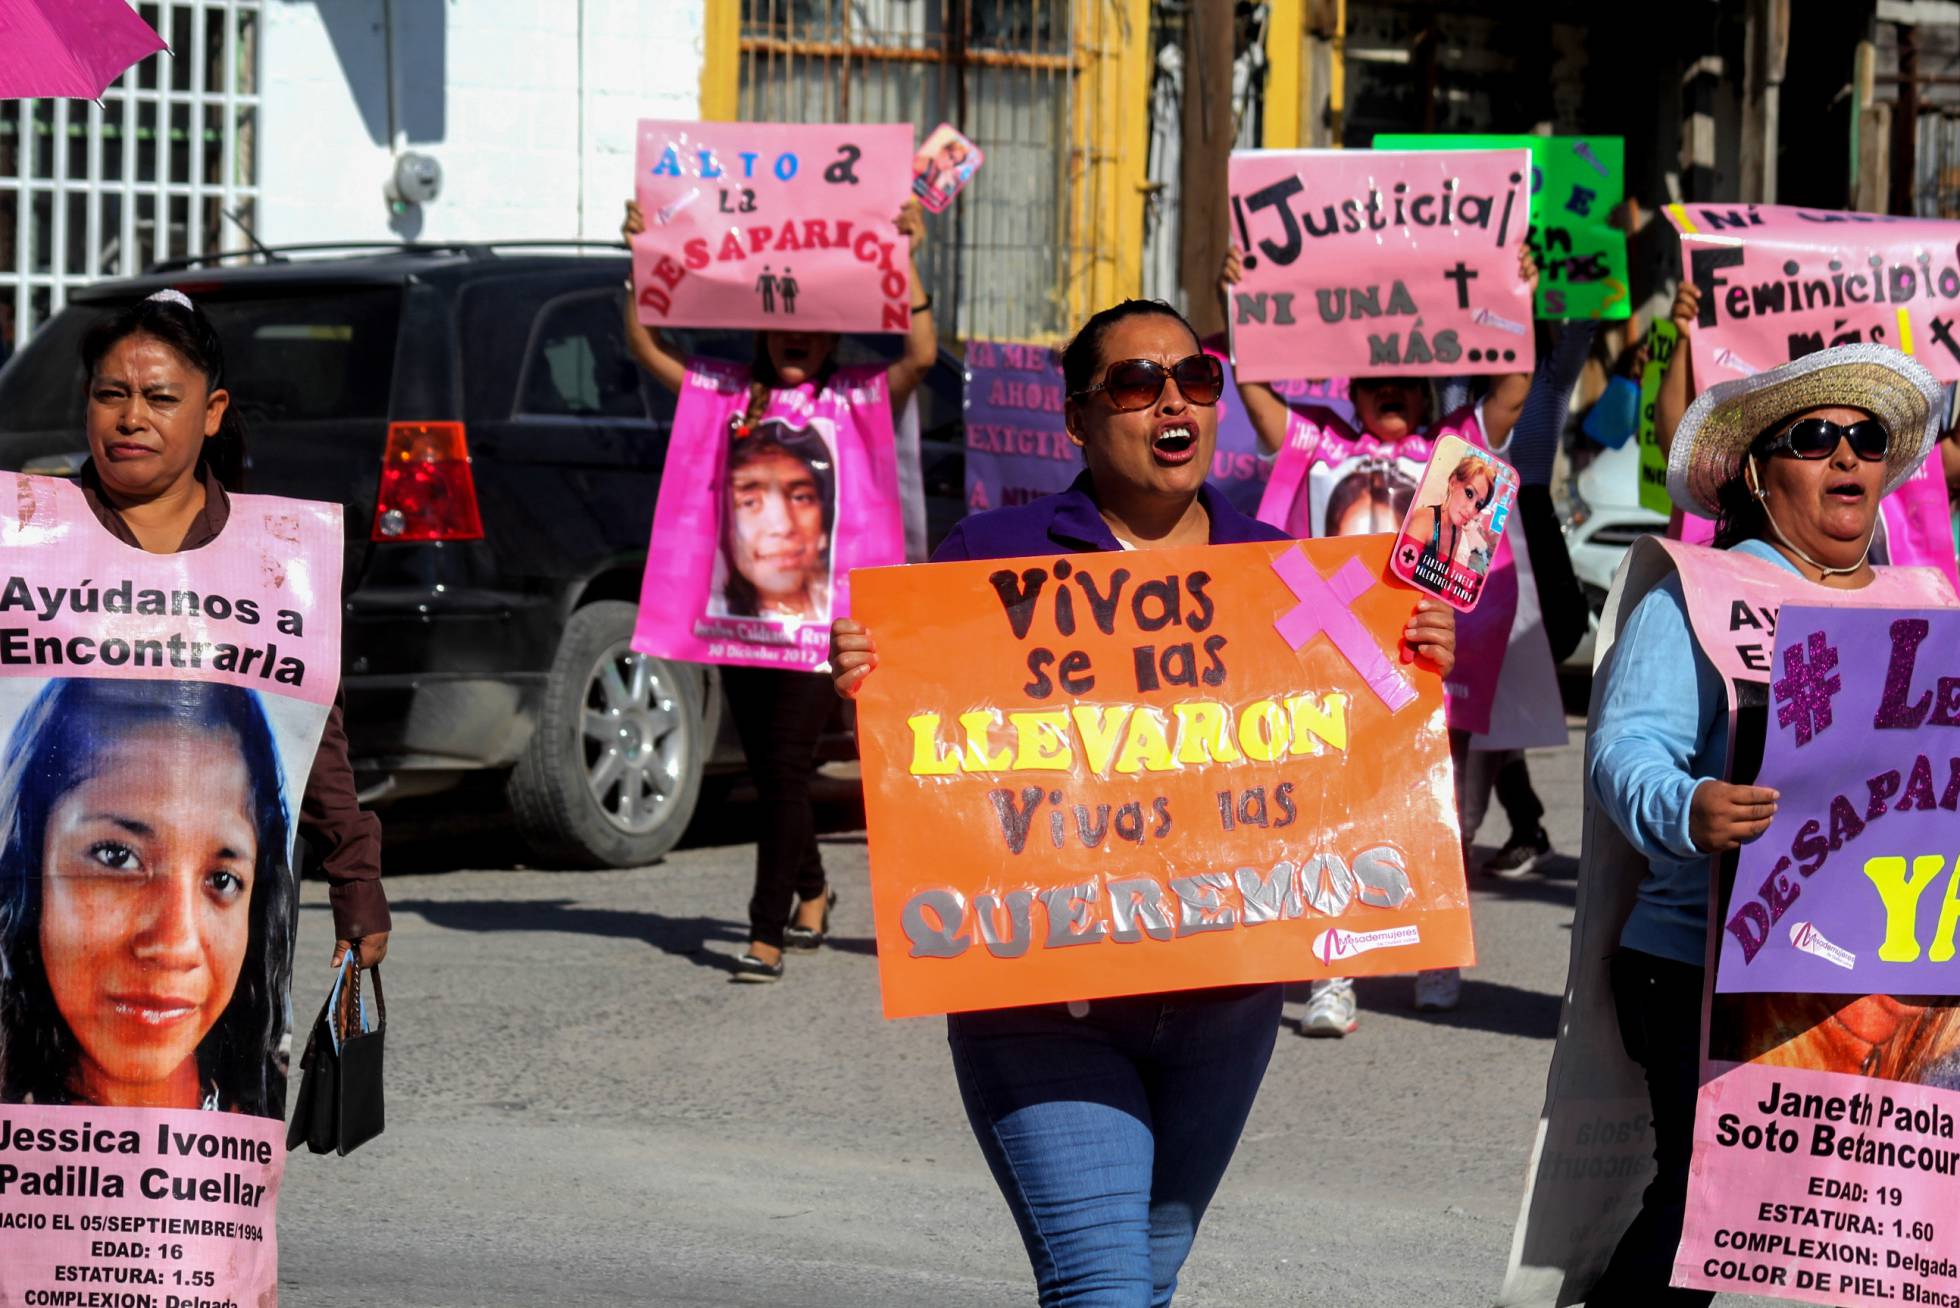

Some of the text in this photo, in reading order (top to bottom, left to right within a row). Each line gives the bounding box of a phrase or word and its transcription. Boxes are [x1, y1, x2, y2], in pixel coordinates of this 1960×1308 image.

[652, 147, 798, 181] ALTO
[638, 219, 911, 331] DESAPARICION
[1236, 280, 1419, 326] NI UNA
[1003, 345, 1045, 373] ME
[1368, 318, 1516, 366] MÁS...
[987, 378, 1065, 414] AHOR
[0, 576, 304, 637] Ayúdanos a
[0, 628, 306, 688] Encontrarla
[1024, 634, 1229, 700] se las
[907, 691, 1352, 778] LLEVARON
[900, 843, 1413, 961] QUEREMOS
[1758, 1082, 1954, 1139] Janeth Paola
[0, 1120, 272, 1165] Jessica Ivonne
[1716, 1113, 1800, 1154] Soto
[0, 1164, 266, 1208] Padilla Cuellar
[1808, 1176, 1903, 1207] EDAD: 19
[52, 1214, 75, 1231] EL
[80, 1215, 263, 1243] 05/SEPTIEMBRE/1994
[1758, 1203, 1934, 1242] ESTATURA: 1.60
[91, 1241, 183, 1260] EDAD: 16
[1713, 1229, 1957, 1279] COMPLEXION: Delgada
[24, 1289, 158, 1308] COMPLEXION:
[55, 1265, 215, 1287] ESTATURA: 1.55
[1703, 1259, 1960, 1308] COLOR DE PIEL: Blanca
